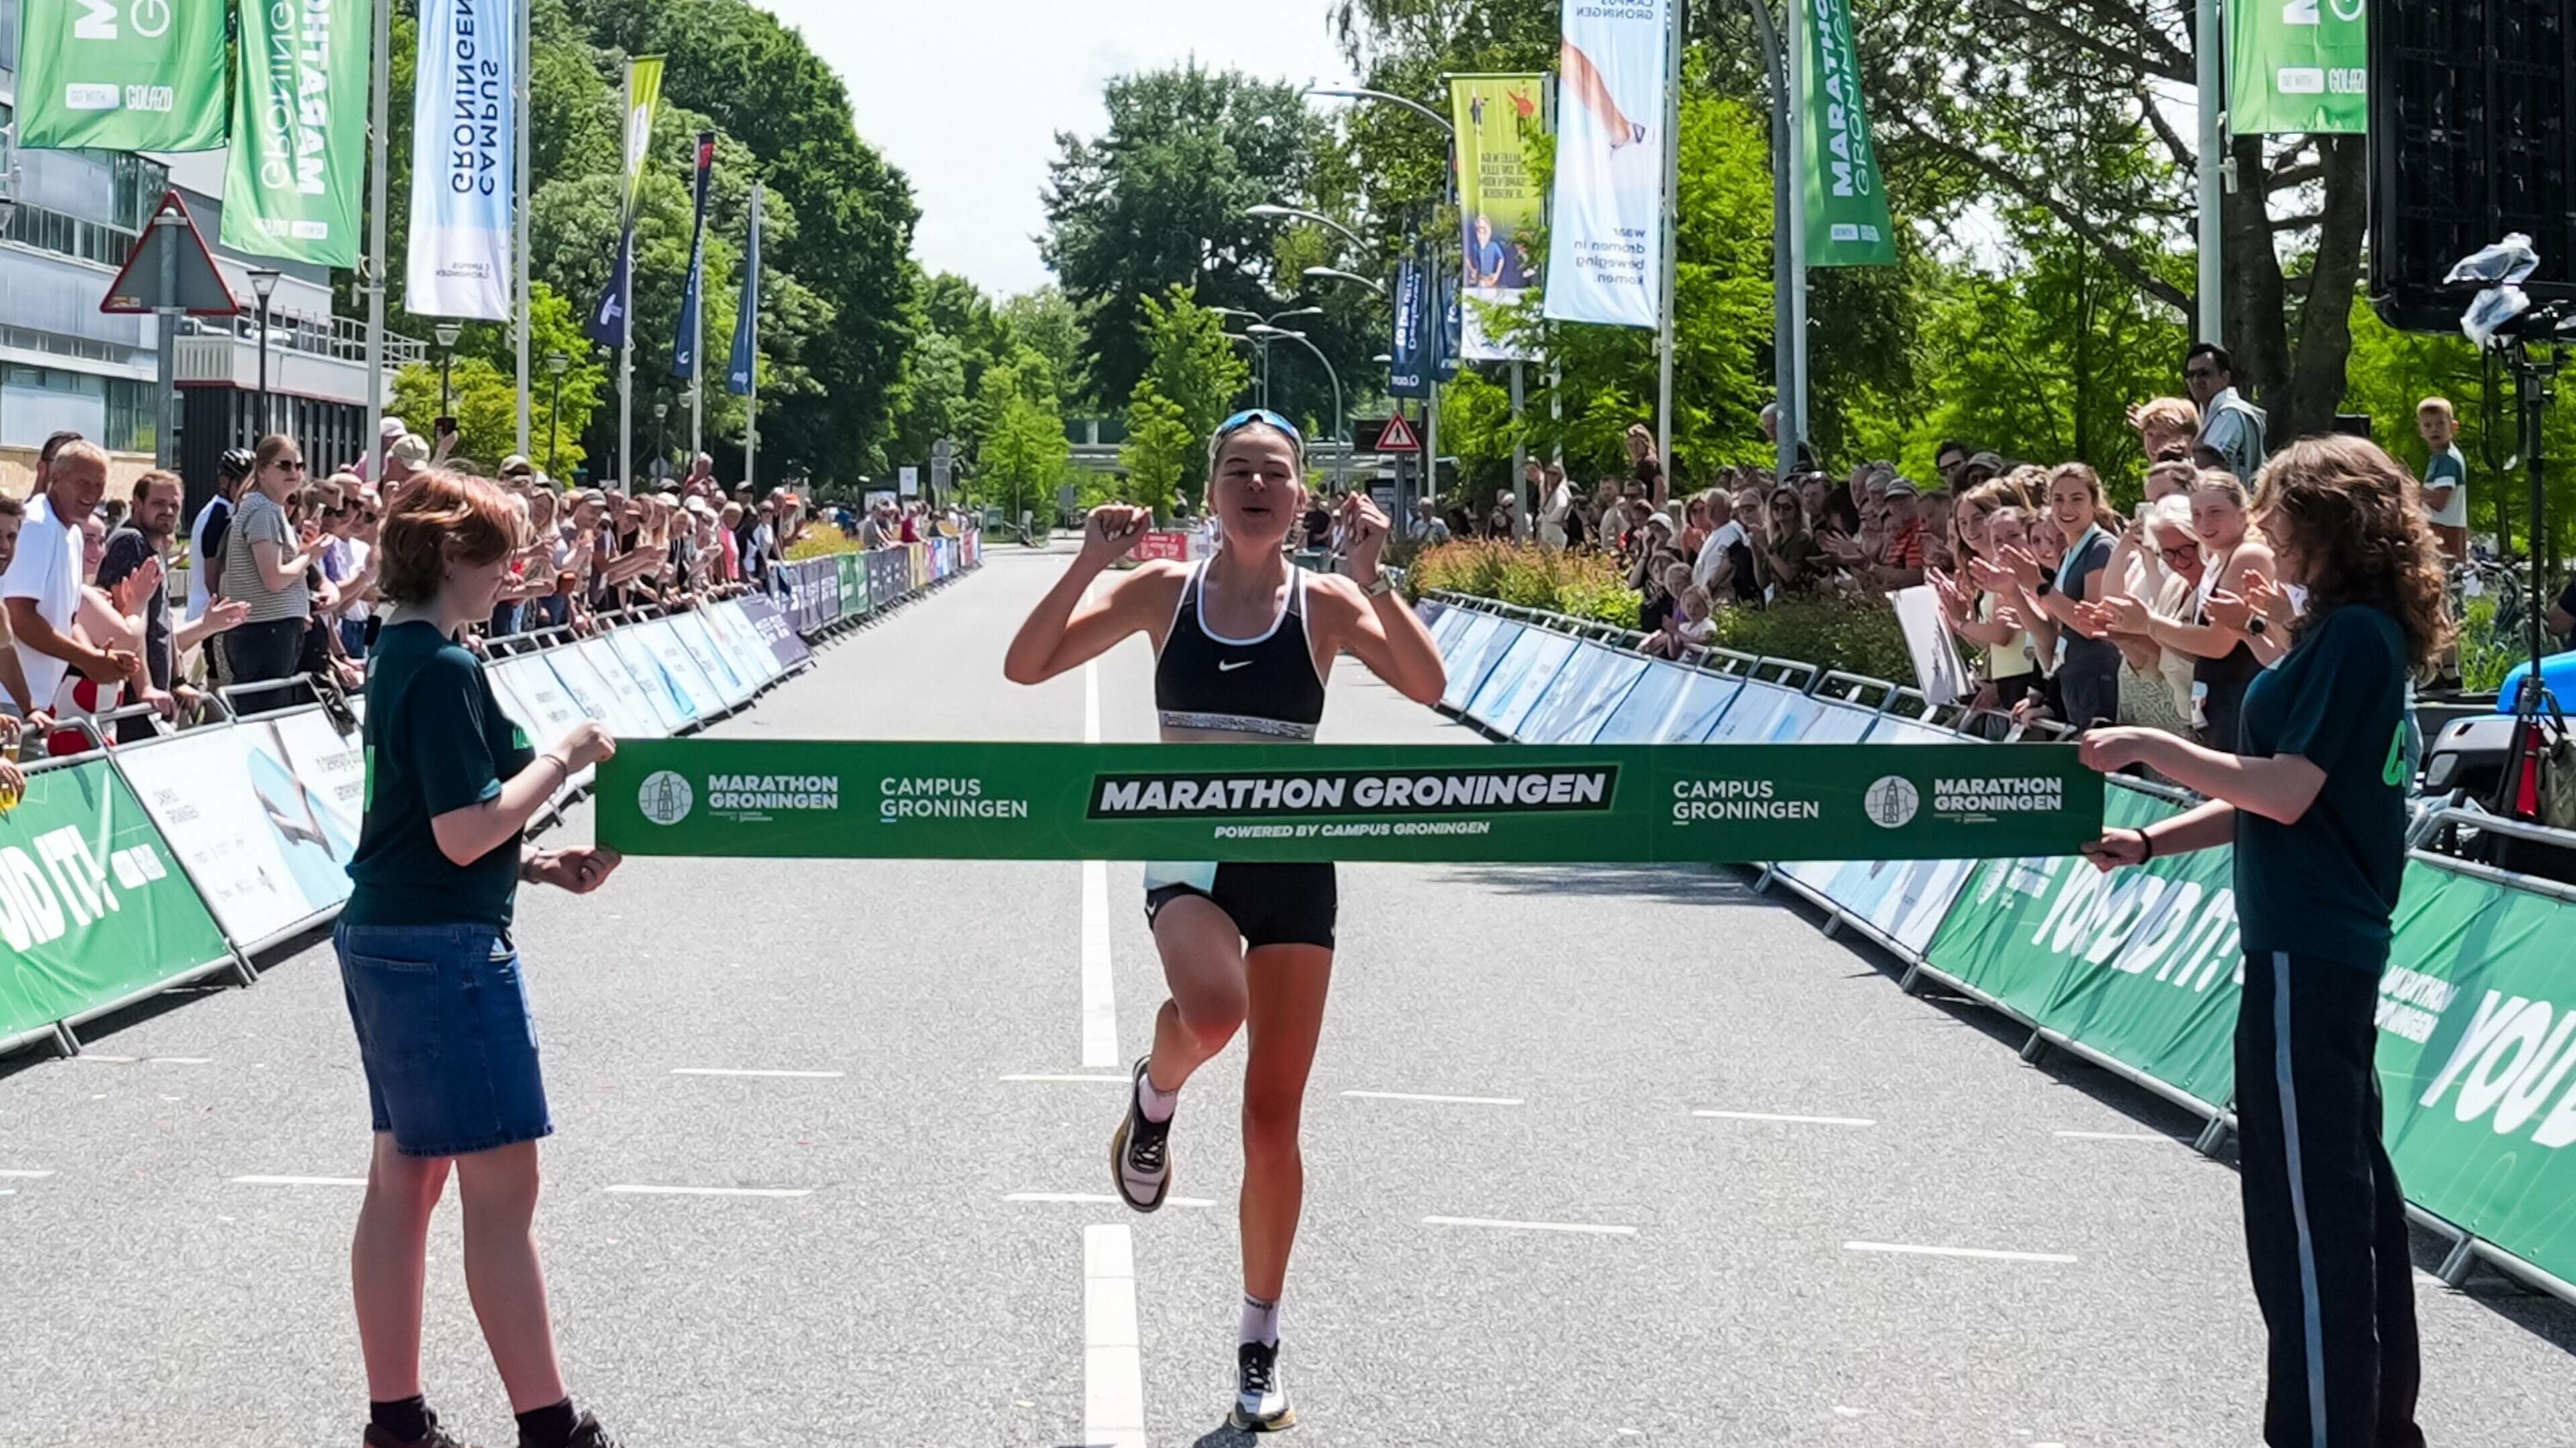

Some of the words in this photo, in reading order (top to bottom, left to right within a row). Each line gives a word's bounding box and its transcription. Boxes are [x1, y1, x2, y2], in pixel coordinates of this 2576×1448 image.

[708, 775, 839, 792] MARATHON
[880, 777, 981, 796] CAMPUS
[1099, 778, 1342, 811] MARATHON
[1352, 773, 1607, 807] GRONINGEN
[1672, 780, 1774, 799] CAMPUS
[1934, 777, 2063, 795] MARATHON
[708, 793, 839, 810] GRONINGEN
[880, 799, 1028, 818] GRONINGEN
[1672, 801, 1819, 820] GRONINGEN
[1934, 795, 2063, 812] GRONINGEN
[1214, 825, 1293, 839] POWERED
[1295, 824, 1319, 838] BY
[1321, 824, 1391, 837] CAMPUS
[1393, 822, 1491, 836] GRONINGEN
